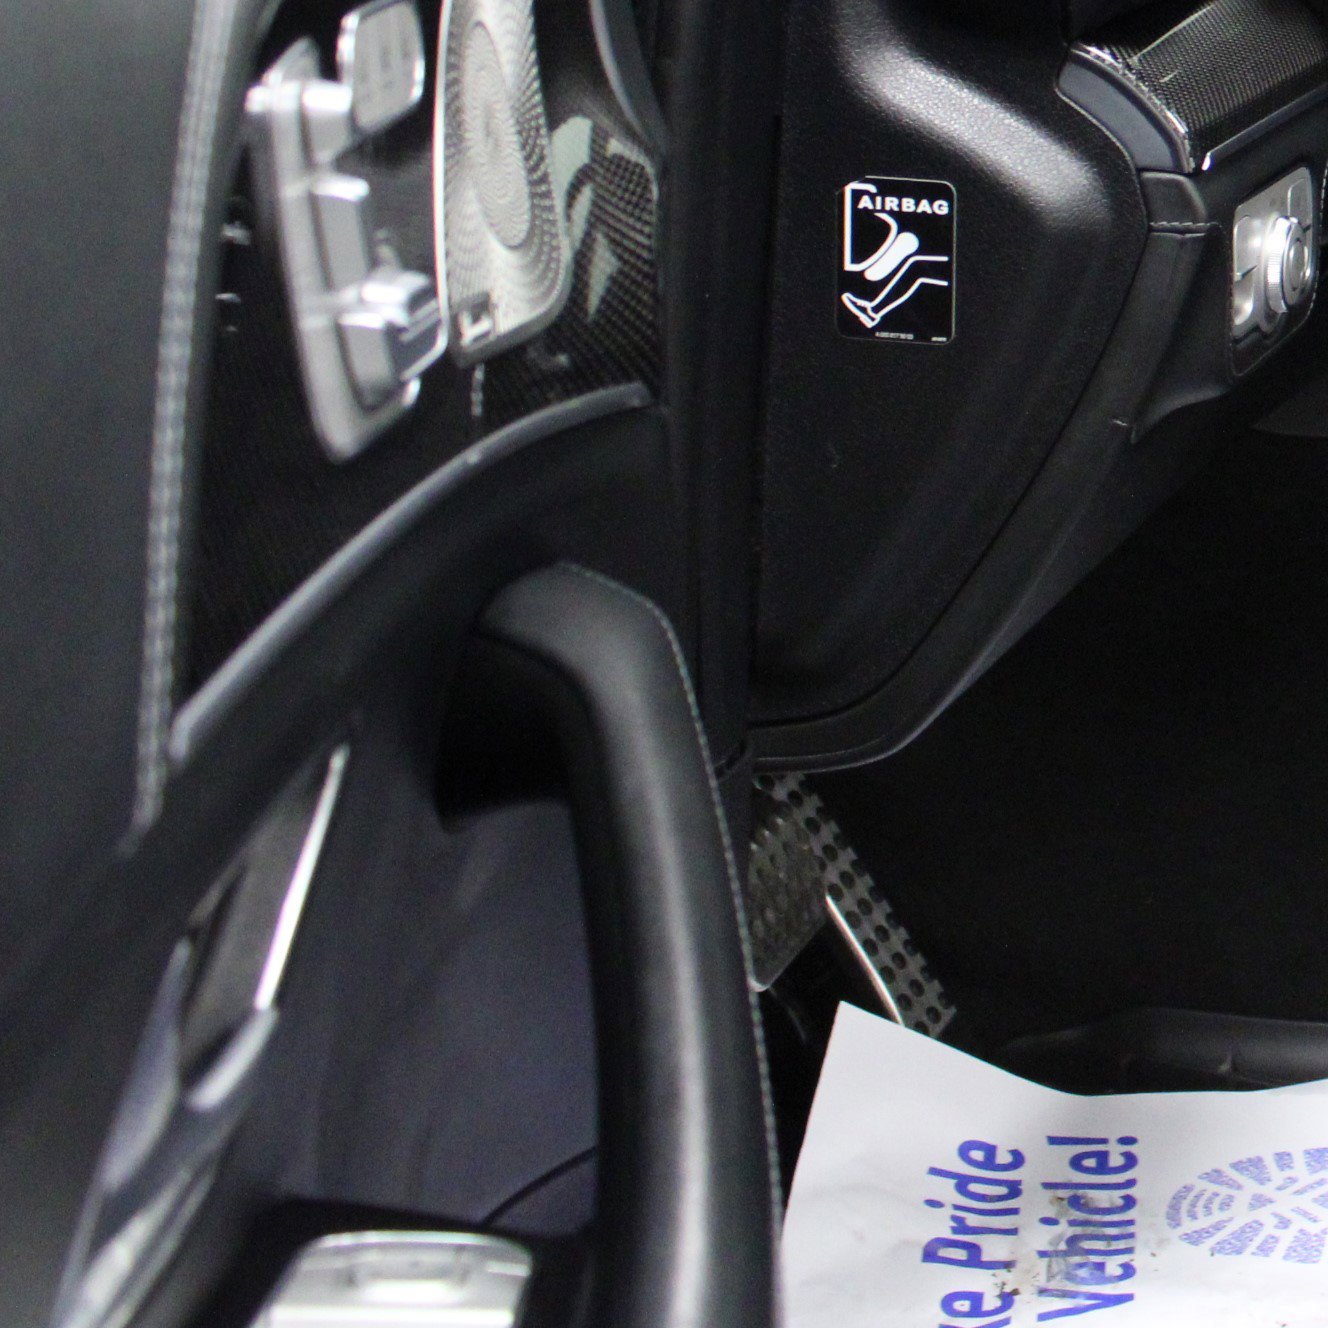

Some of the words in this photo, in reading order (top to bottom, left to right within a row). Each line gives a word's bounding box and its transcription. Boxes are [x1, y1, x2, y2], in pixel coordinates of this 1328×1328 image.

[857, 194, 950, 215] AIRBAG
[920, 1139, 1026, 1271] Pride
[1036, 1135, 1139, 1322] Vehicle!
[937, 1290, 1016, 1328] e
